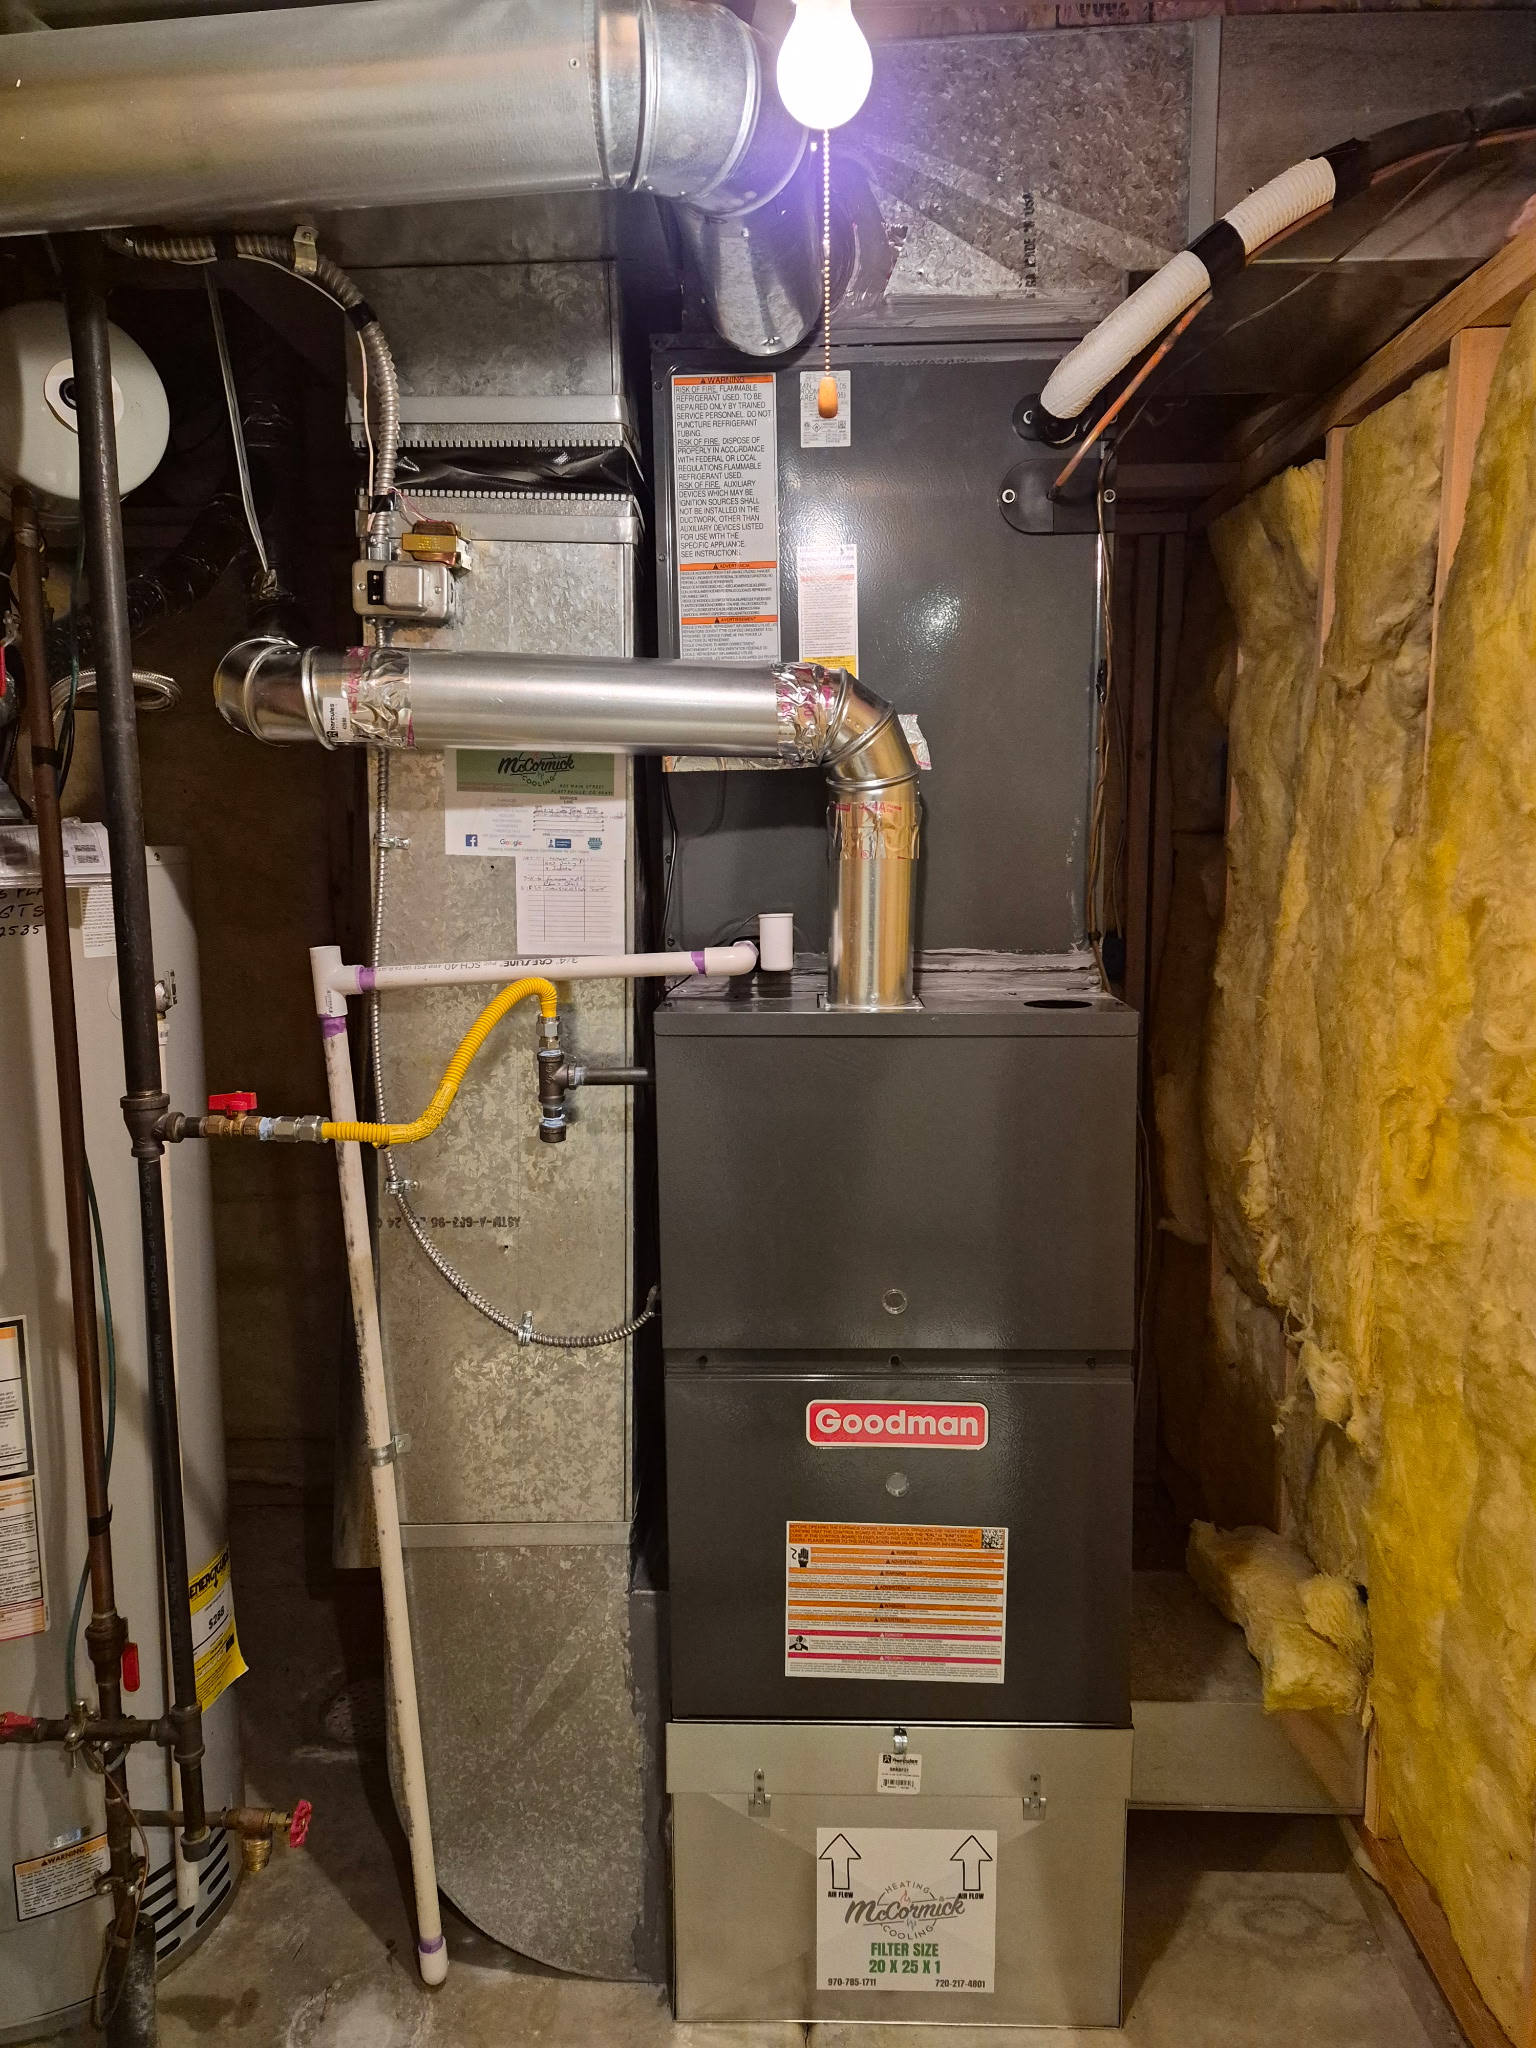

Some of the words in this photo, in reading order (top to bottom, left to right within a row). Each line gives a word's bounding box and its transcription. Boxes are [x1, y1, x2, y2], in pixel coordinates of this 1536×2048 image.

[720, 384, 757, 392] FLAMMABLE
[676, 394, 720, 402] REFRIGERANT
[677, 403, 708, 411] REPAIRED
[678, 447, 711, 455] PROPERLY
[721, 445, 765, 453] ACCORDANCE
[328, 703, 336, 730] hercules
[498, 754, 575, 774] McCormick
[522, 774, 556, 787] COOLING
[500, 838, 522, 847] Google
[814, 1408, 980, 1436] Goodman
[48, 1846, 86, 1866] WARNING
[884, 1880, 930, 1894] HEATING
[958, 1892, 967, 1900] AIR
[844, 1896, 965, 1924] McCormick
[882, 1924, 935, 1940] COOLING
[871, 1943, 909, 1957] FILTER
[913, 1944, 939, 1957] SIZE
[869, 1959, 886, 1973] 20
[890, 1960, 898, 1973] X
[902, 1960, 919, 1974] 25
[923, 1960, 931, 1974] X
[935, 1960, 941, 1974] 1
[828, 1978, 877, 1987] 970-785-1711
[935, 1979, 986, 1988] 720-217-4801
